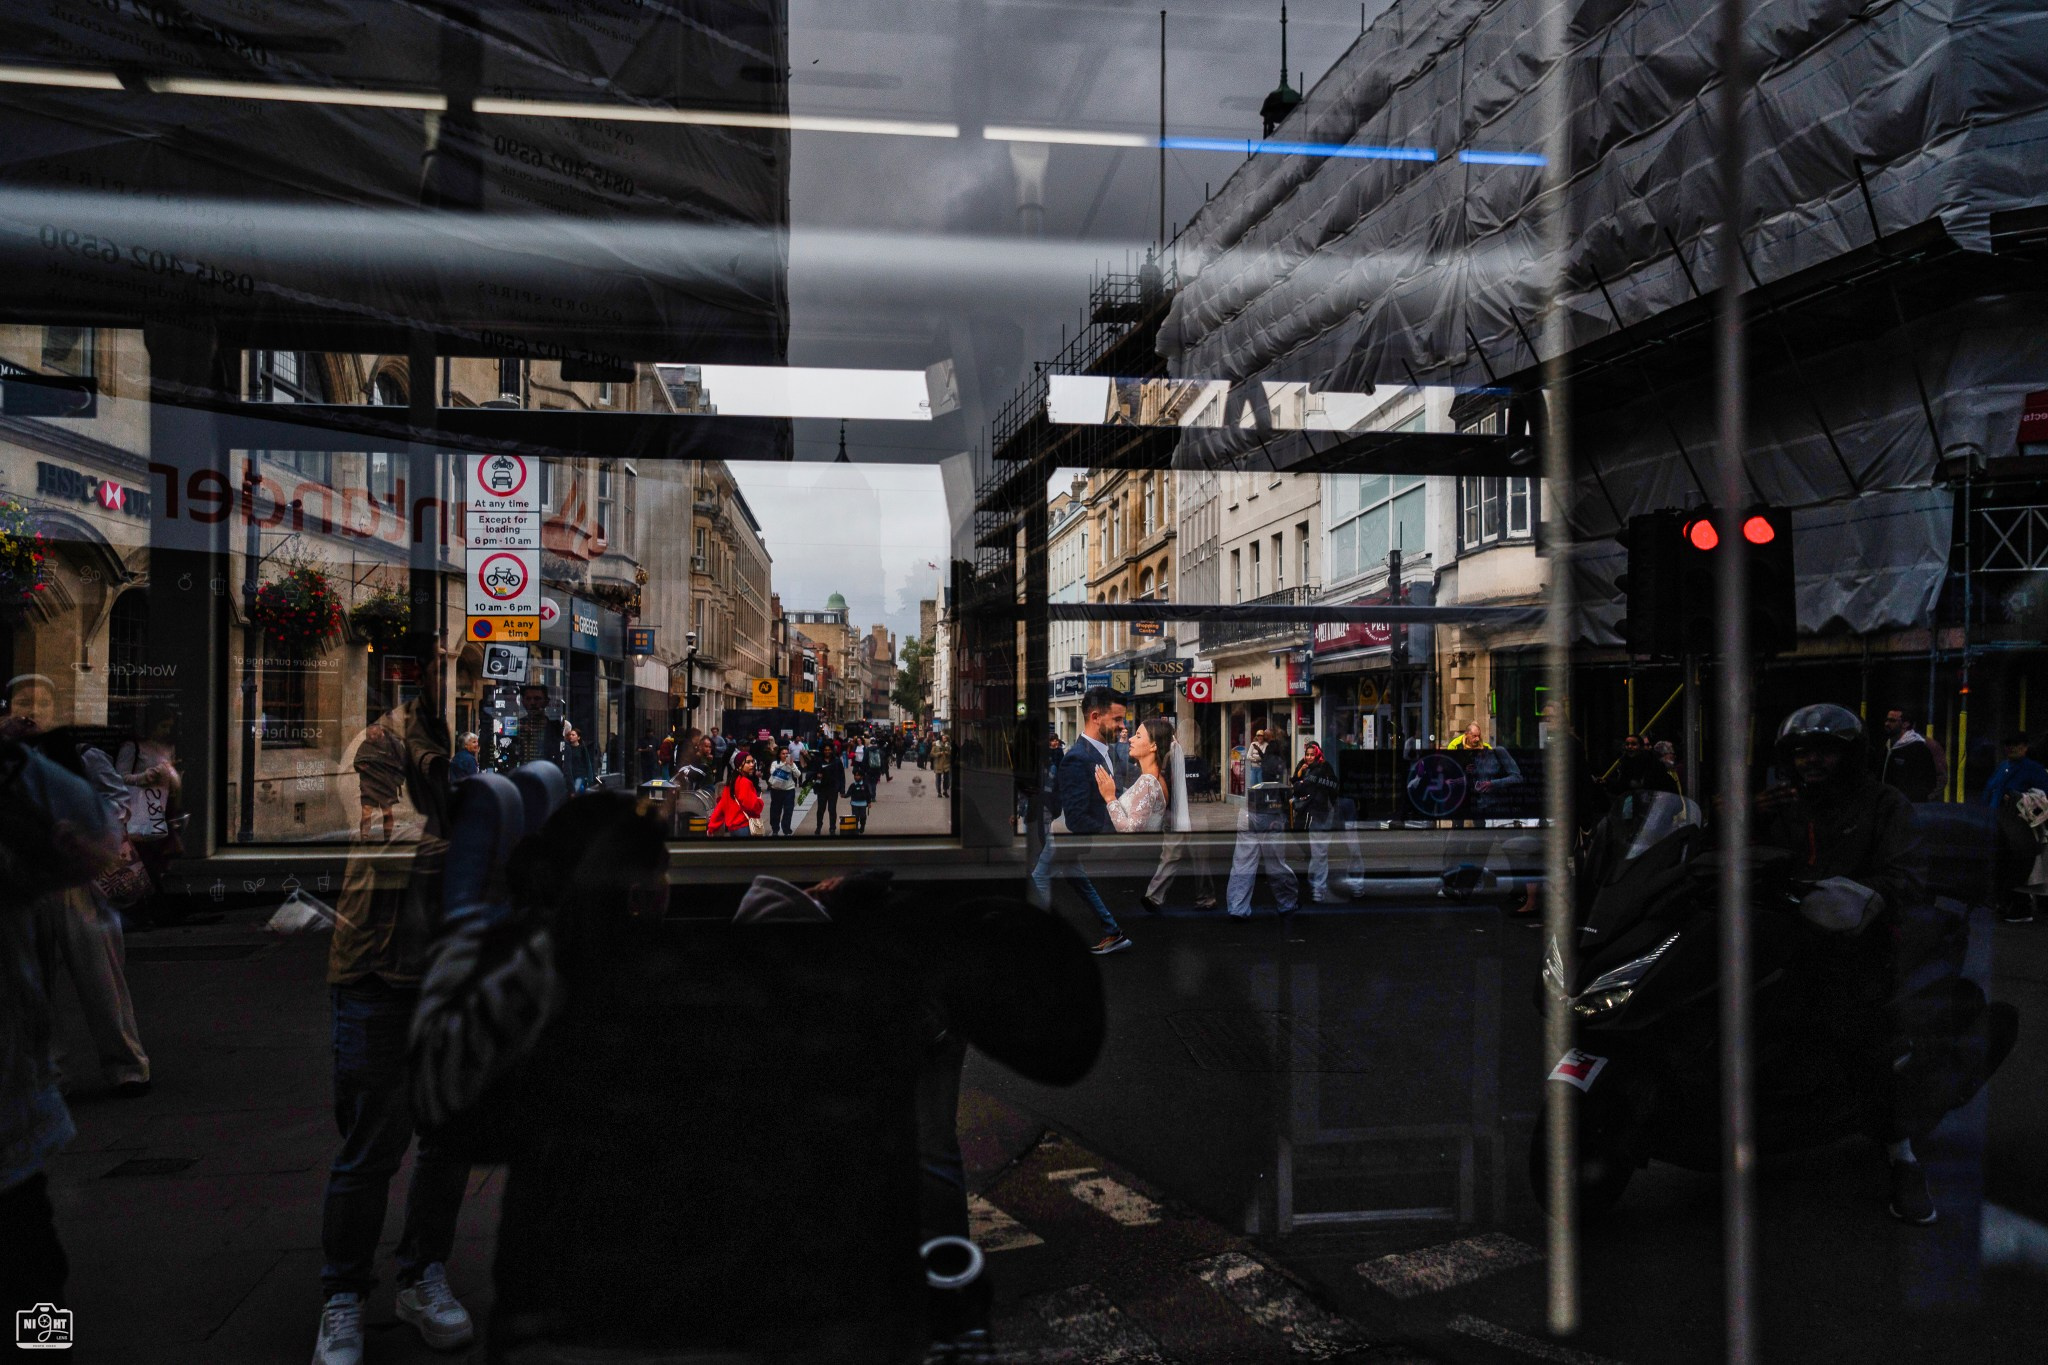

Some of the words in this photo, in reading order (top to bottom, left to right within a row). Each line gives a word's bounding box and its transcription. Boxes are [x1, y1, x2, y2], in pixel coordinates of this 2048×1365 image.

[37, 461, 98, 503] HSBC
[475, 499, 486, 508] At
[489, 501, 506, 509] any
[508, 499, 530, 508] time
[478, 515, 512, 525] Except
[514, 515, 528, 523] for
[485, 525, 521, 535] loading
[474, 537, 481, 545] 6
[483, 538, 497, 547] pm
[505, 537, 515, 545] 10
[475, 603, 485, 611] 10
[509, 603, 515, 611] 6
[517, 605, 532, 613] pm
[503, 620, 515, 628] At
[517, 621, 534, 630] any
[579, 615, 599, 638] GREGGS
[1135, 622, 1160, 630] Shopping
[508, 629, 529, 638] time
[1148, 661, 1184, 674] CROSS
